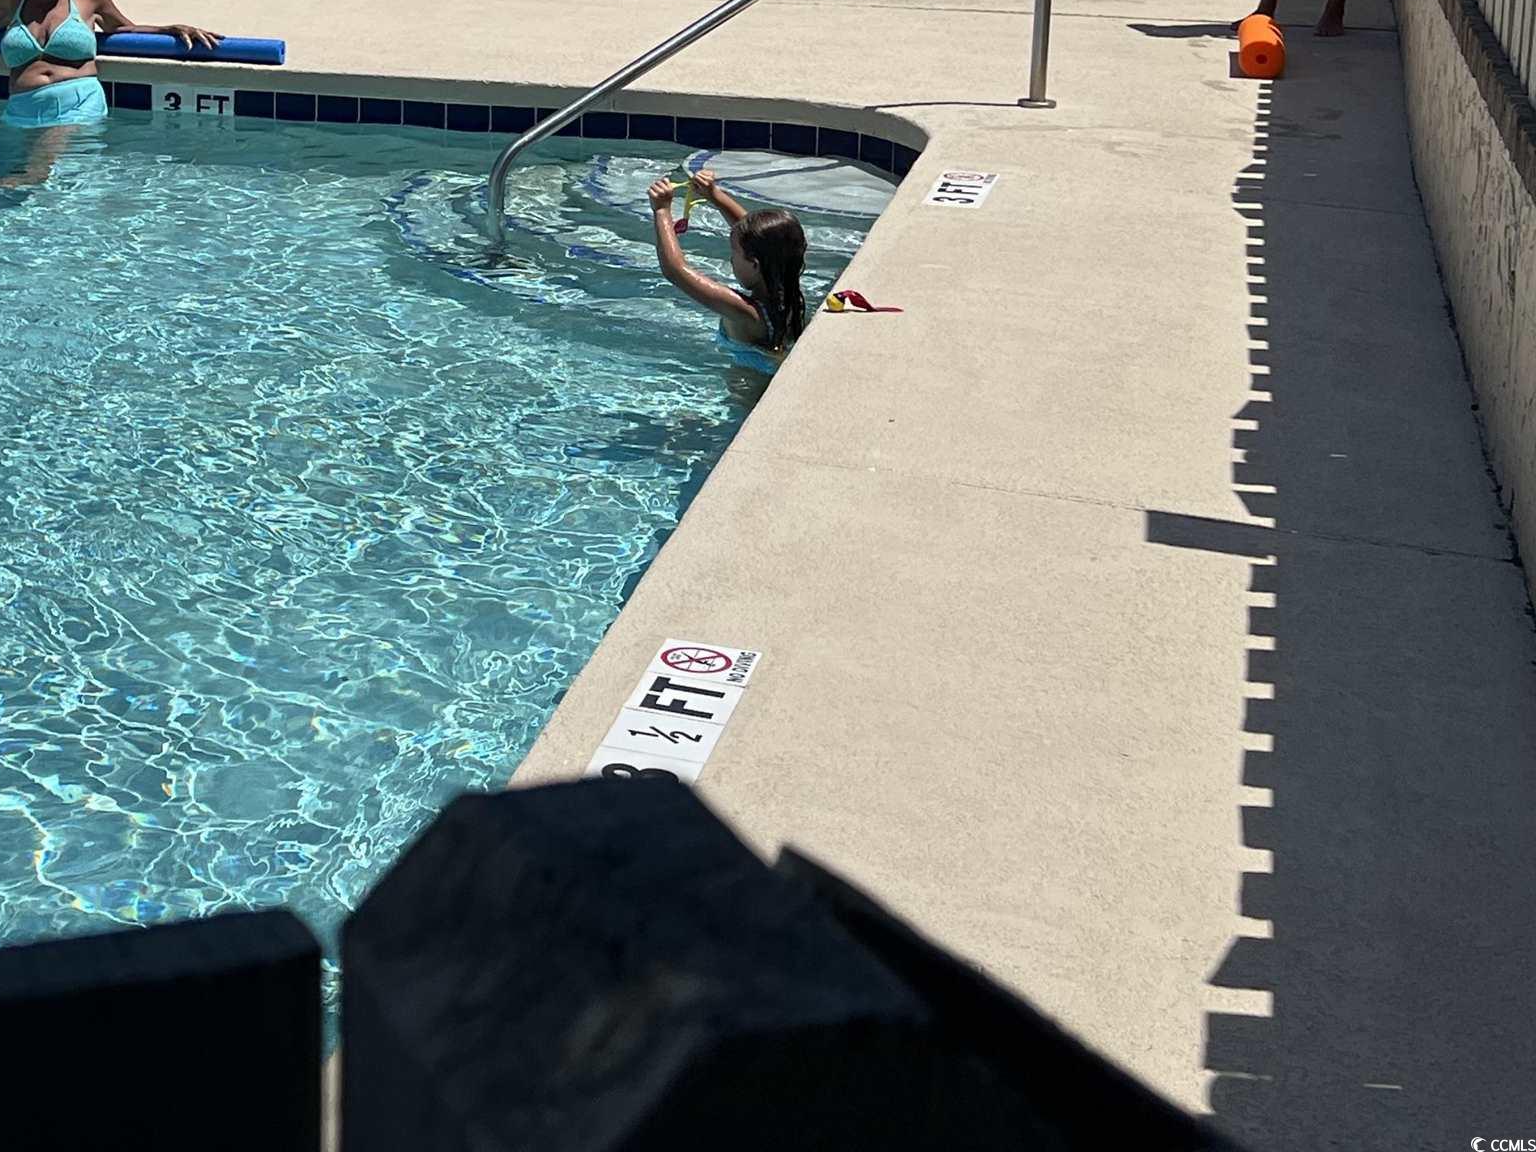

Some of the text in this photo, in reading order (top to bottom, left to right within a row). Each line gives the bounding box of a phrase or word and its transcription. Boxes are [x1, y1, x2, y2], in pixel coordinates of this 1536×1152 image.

[163, 92, 230, 114] 3 FT
[937, 181, 983, 196] FT
[726, 652, 757, 683] NO DIVING
[639, 675, 726, 720] FT
